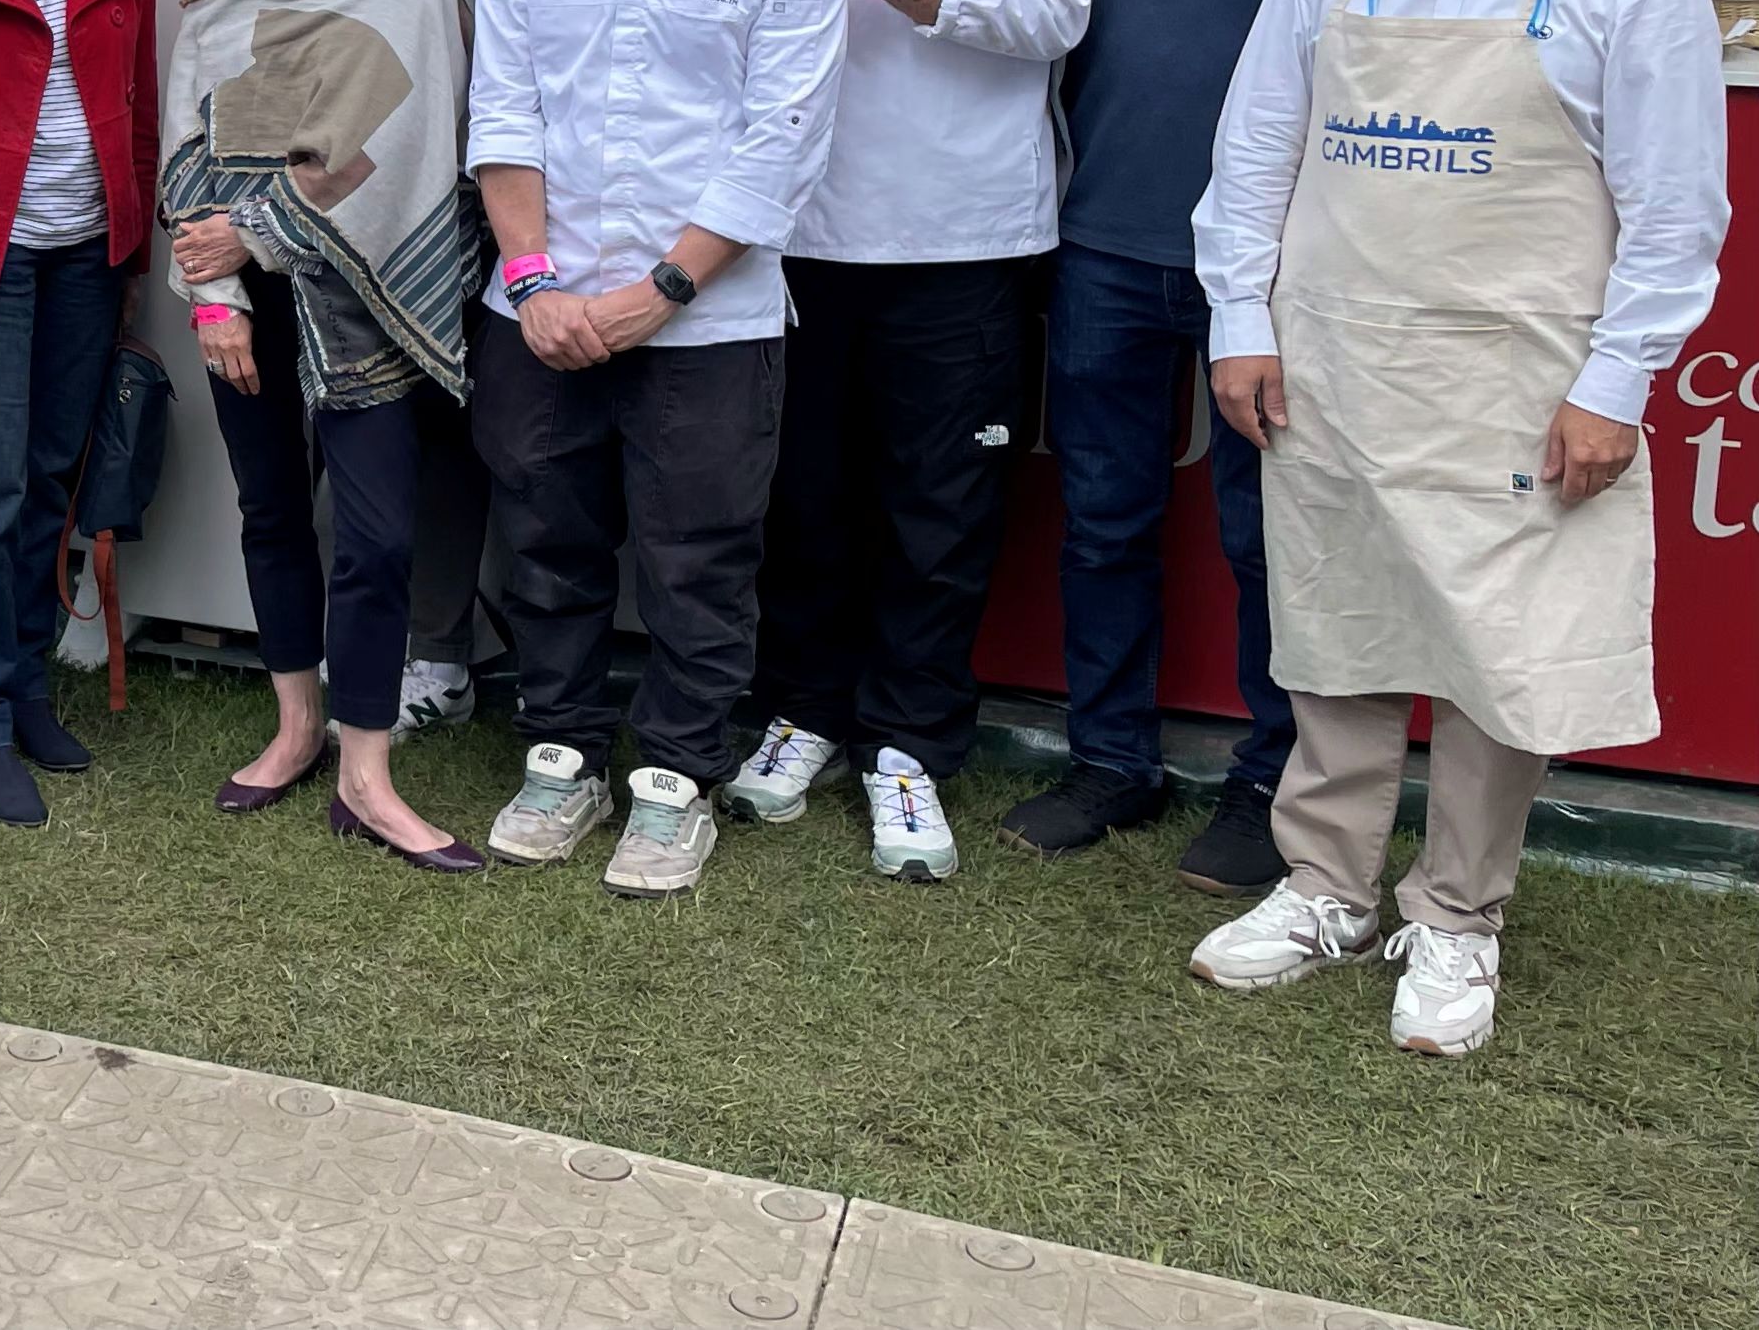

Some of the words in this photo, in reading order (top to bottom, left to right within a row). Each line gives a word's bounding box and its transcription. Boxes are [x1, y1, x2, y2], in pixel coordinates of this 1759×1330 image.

[1322, 136, 1493, 174] CAMBRILS
[538, 746, 563, 764] VANS
[651, 772, 679, 793] VANS
